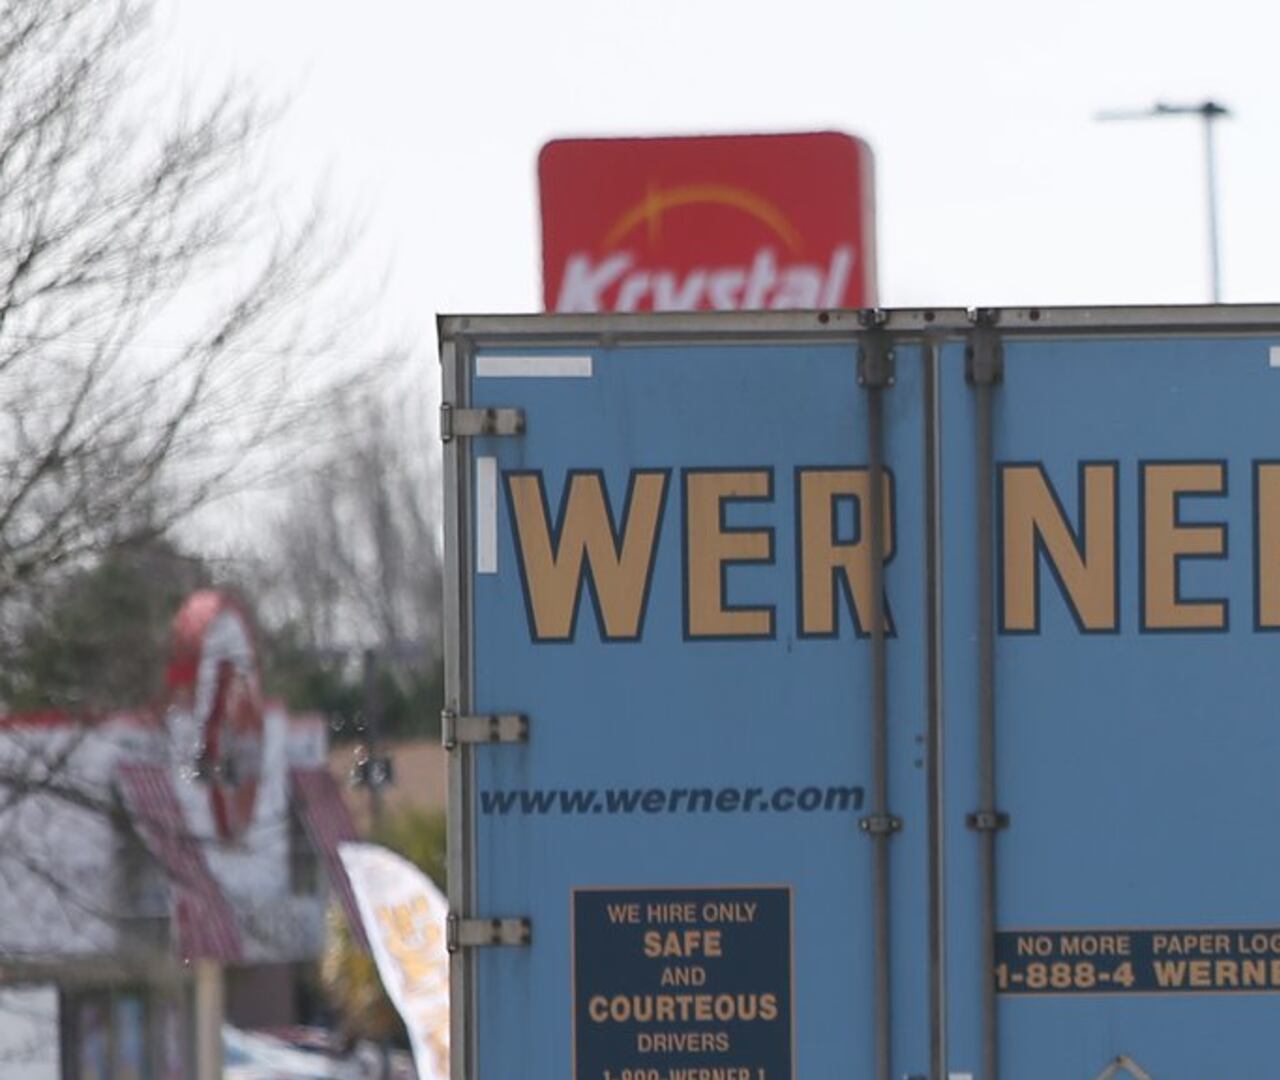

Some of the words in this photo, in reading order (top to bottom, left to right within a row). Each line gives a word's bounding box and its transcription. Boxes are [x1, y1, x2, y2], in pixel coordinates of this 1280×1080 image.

[478, 782, 865, 816] www.werner.com
[608, 905, 640, 923] WE
[648, 904, 696, 923] HIRE
[703, 903, 757, 922] ONLY
[644, 931, 722, 957] SAFE
[1017, 937, 1053, 956] NO
[1060, 936, 1131, 955] MORE
[1153, 934, 1230, 955] PAPER
[661, 967, 706, 986] AND
[994, 962, 1135, 988] 1-888-4
[589, 995, 779, 1022] COURTEOUS
[637, 1033, 730, 1053] DRIVERS
